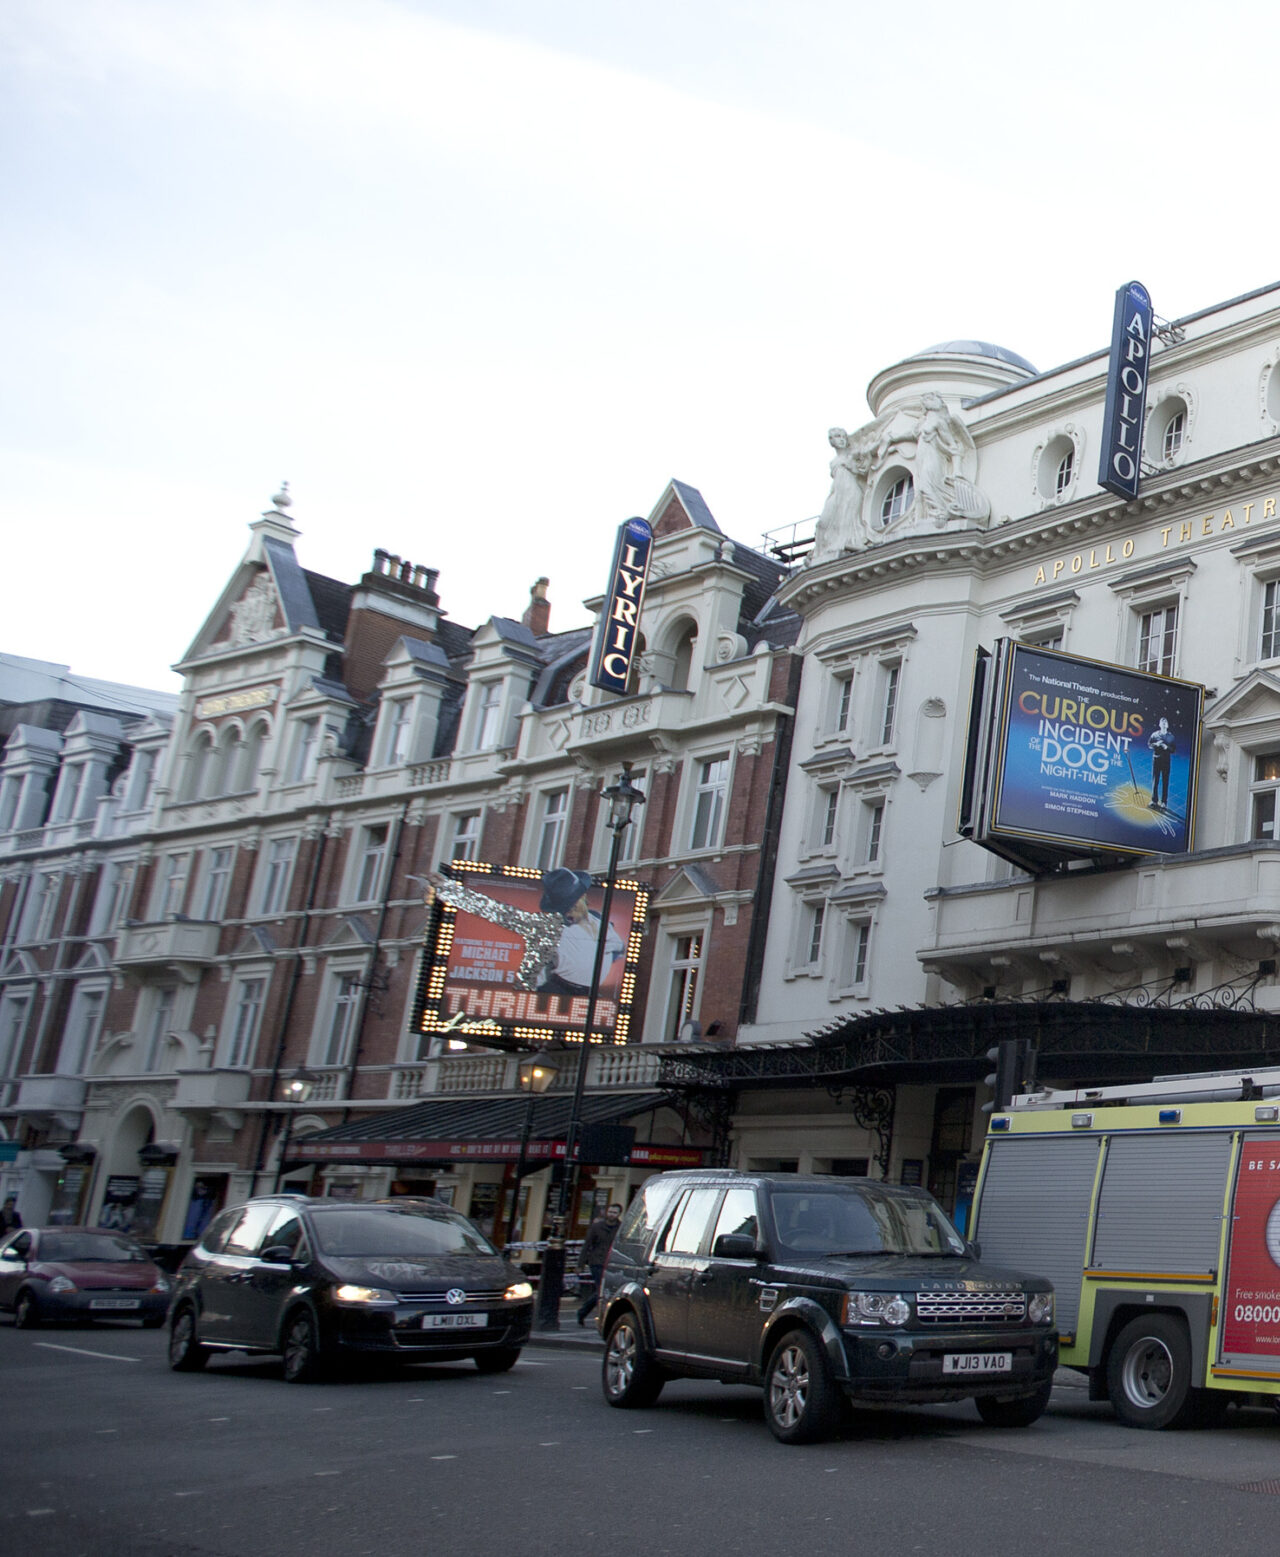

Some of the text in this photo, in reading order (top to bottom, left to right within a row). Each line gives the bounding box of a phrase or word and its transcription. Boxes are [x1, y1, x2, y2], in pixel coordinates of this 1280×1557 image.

[1113, 312, 1146, 480] APOLLO
[1034, 539, 1135, 585] APOLLO
[604, 544, 644, 679] LYRIC
[1029, 674, 1040, 682] The
[1042, 676, 1072, 689] National
[1072, 682, 1100, 695] Theatre
[1100, 690, 1132, 702] production
[1078, 696, 1090, 704] THE
[1018, 690, 1144, 737] CURIOUS
[1030, 736, 1040, 744] OF
[1038, 718, 1132, 754] INCIDENT
[1028, 743, 1041, 751] THE
[1042, 738, 1109, 772] DOG
[1110, 759, 1123, 767] THE
[1040, 762, 1108, 786] NIGHT-TIME
[1070, 795, 1096, 804] HADDON
[1045, 803, 1099, 818] SIMON STEPHENS
[462, 946, 509, 962] MICHAEL
[450, 966, 514, 983] JACKSON 5
[446, 987, 617, 1027] THRILLER
[1249, 1160, 1263, 1171] BE
[1236, 1288, 1253, 1299] Free
[1255, 1289, 1280, 1300] smoke
[1235, 1305, 1280, 1323] 08000
[952, 1356, 979, 1370] WJ13
